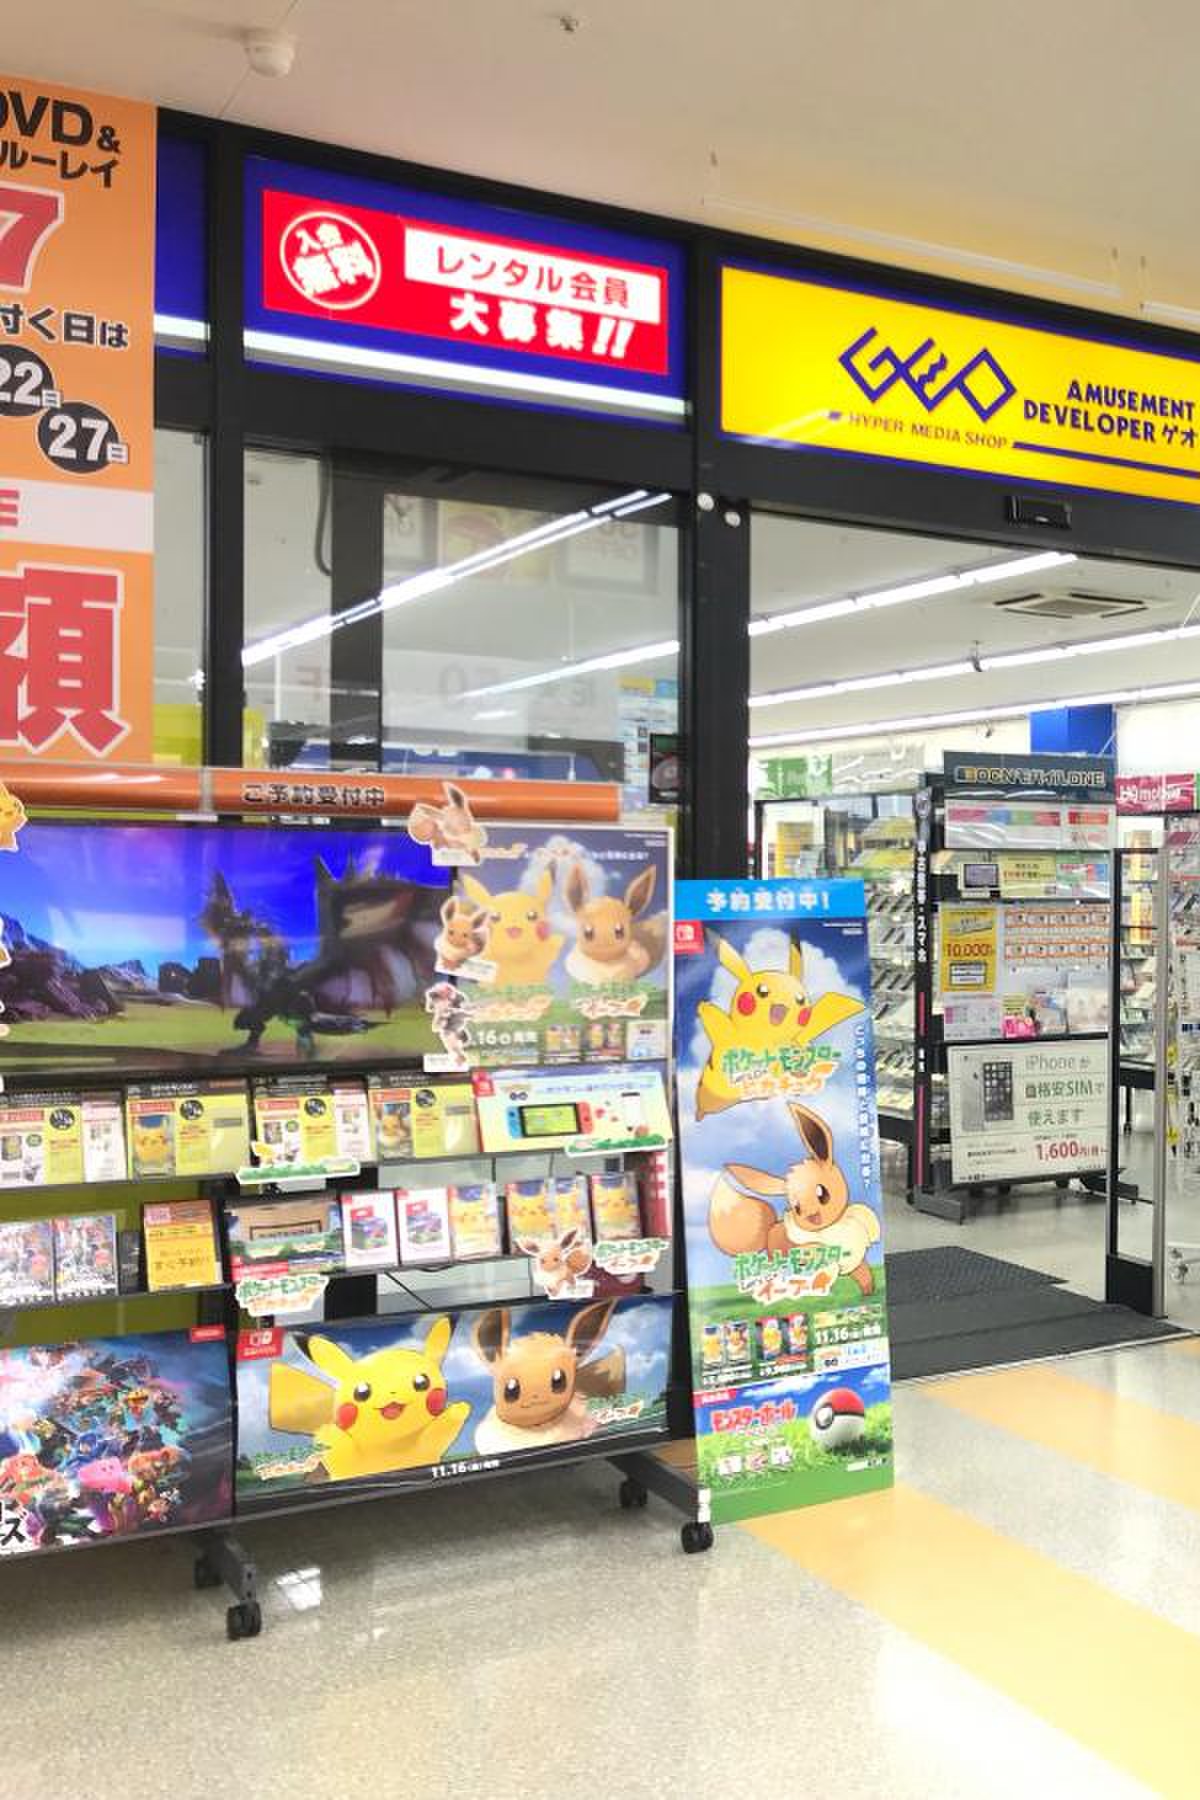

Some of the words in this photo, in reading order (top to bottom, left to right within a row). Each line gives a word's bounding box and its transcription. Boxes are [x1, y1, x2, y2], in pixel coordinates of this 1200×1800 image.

[0, 90, 121, 152] VD&
[436, 246, 630, 308] レンタル会員
[838, 325, 1017, 423] GEO
[1066, 379, 1196, 422] AMUSEMENT
[848, 412, 904, 434] HYPER
[910, 422, 961, 444] MEDIA
[965, 430, 1008, 450] SHOP
[1023, 399, 1155, 443] DEVELOPER
[1161, 424, 1199, 449] ゲオ
